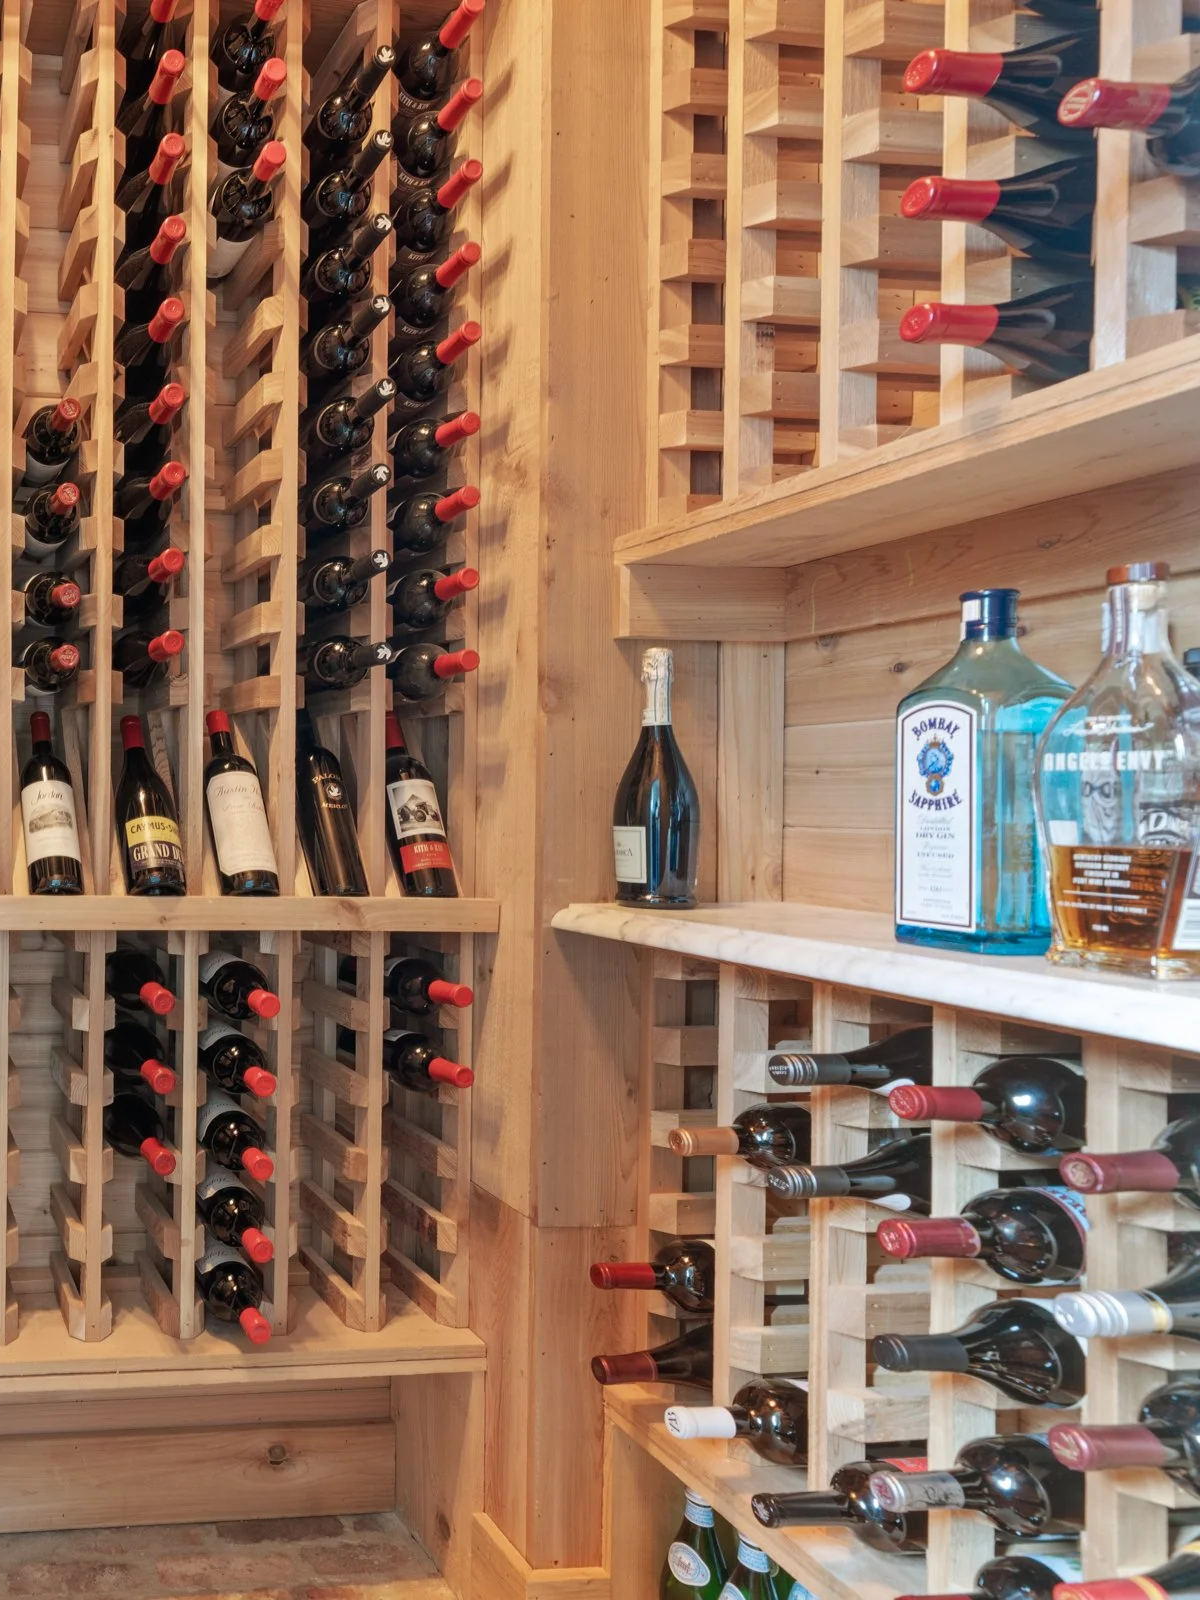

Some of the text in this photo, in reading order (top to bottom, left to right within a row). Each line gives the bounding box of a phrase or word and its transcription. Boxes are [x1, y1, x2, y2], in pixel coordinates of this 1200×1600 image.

[912, 716, 960, 739] BOMBAY
[1116, 750, 1165, 771] ENVY
[32, 789, 64, 804] Jordan
[213, 784, 248, 797] Austin
[908, 788, 962, 811] SAPPHIRE
[133, 843, 170, 862] GRAND
[413, 844, 428, 854] KITH
